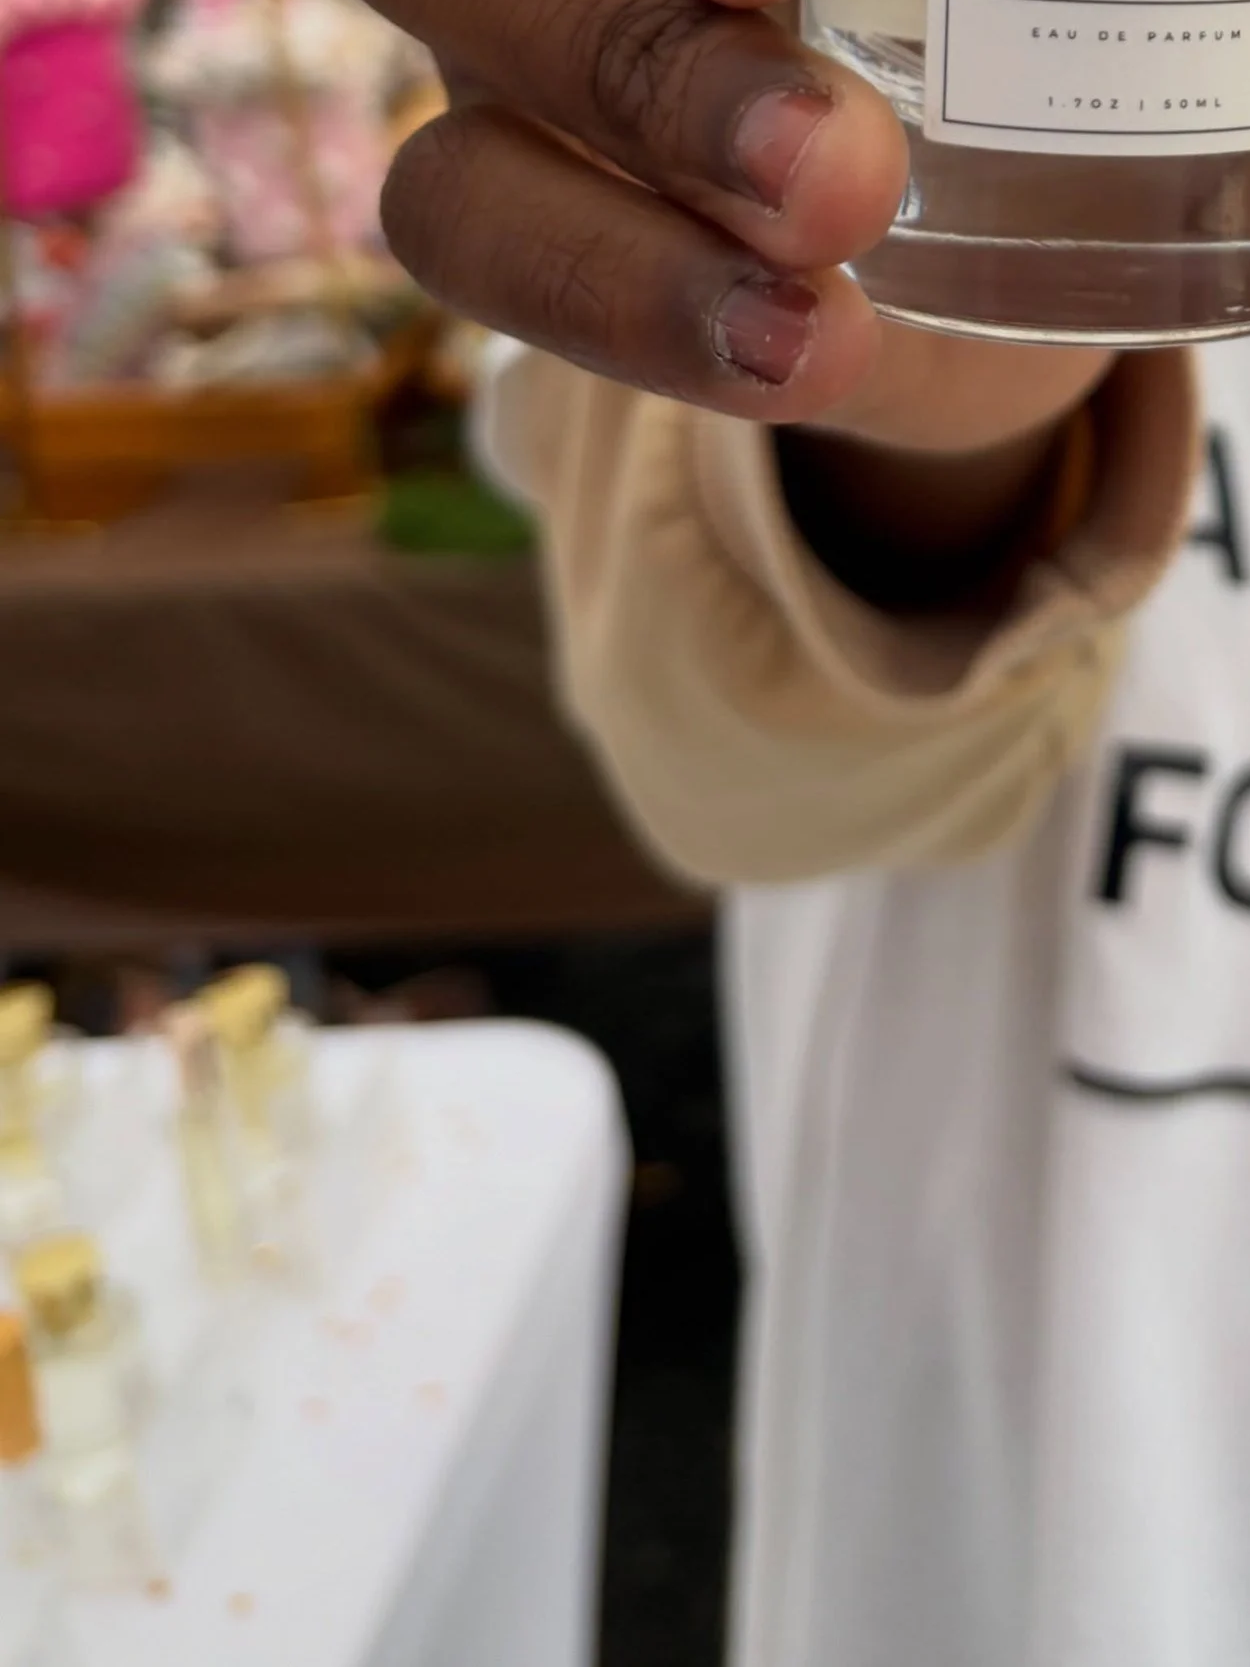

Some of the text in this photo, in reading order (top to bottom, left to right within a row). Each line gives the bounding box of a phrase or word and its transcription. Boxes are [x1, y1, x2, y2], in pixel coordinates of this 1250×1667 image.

[1031, 26, 1241, 42] EAU DE PARFUM
[1048, 95, 1119, 110] 1.7OZ
[1163, 97, 1223, 110] 50ML
